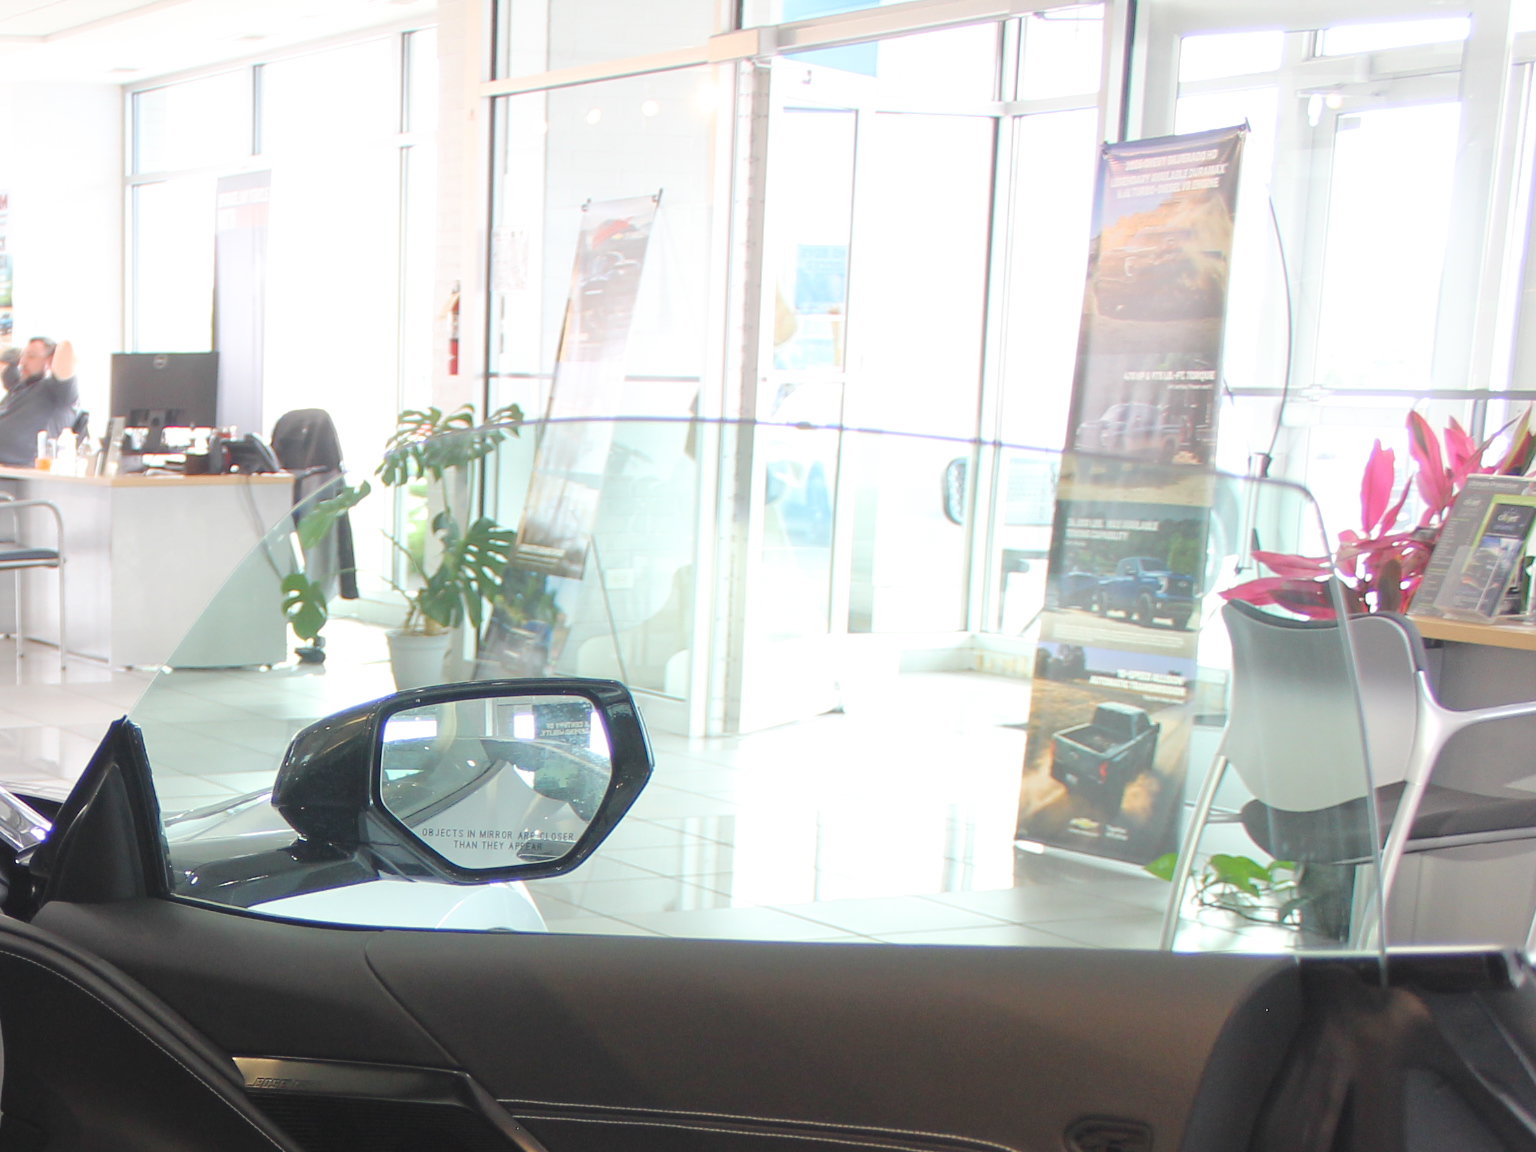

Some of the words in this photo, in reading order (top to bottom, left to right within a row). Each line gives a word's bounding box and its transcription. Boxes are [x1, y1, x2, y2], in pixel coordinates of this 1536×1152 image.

[421, 827, 464, 838] OBJECTS
[467, 828, 476, 839] IN
[479, 829, 513, 840] MIRROR
[517, 831, 535, 840] ARE
[539, 831, 575, 841] CLOSER
[454, 839, 478, 849] THAN
[482, 840, 504, 850] THEY
[507, 841, 543, 851] APPEAR
